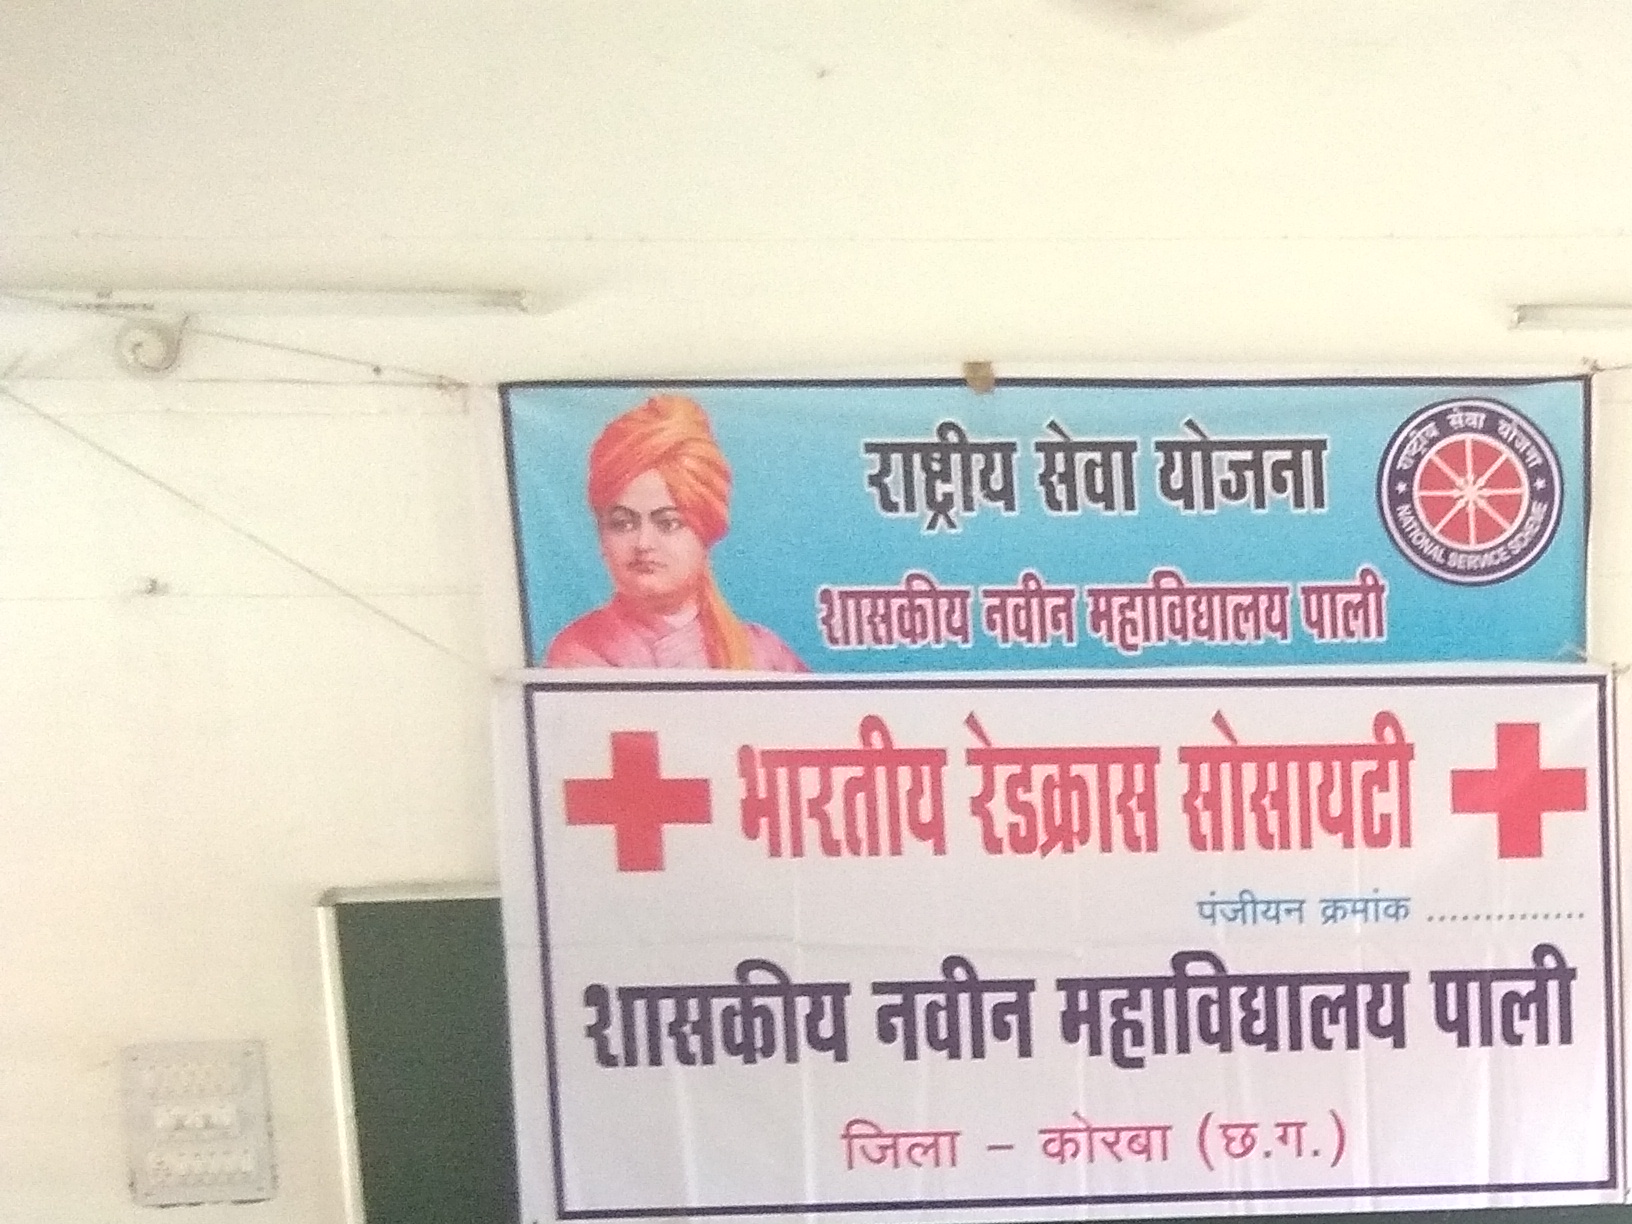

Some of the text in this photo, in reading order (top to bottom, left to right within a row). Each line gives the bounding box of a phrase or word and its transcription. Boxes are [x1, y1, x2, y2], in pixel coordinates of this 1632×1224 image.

[865, 419, 1327, 530] राष्ट्रीय सेवा योजना
[1397, 504, 1446, 563] NATIONAL
[1448, 549, 1510, 569] SERVICE
[820, 567, 1387, 652] शासकीय नवीन महाविद्यालय पाली
[738, 709, 1415, 859] भारतीय रेडक्रास सोसायटी
[1197, 892, 1304, 926] पंजीयन
[1320, 889, 1411, 926] क्रमांक
[584, 942, 1576, 1068] शासकीय नवीन महाविद्यालय पाली
[842, 1122, 960, 1171] जिला
[1042, 1111, 1172, 1166] कोरबा
